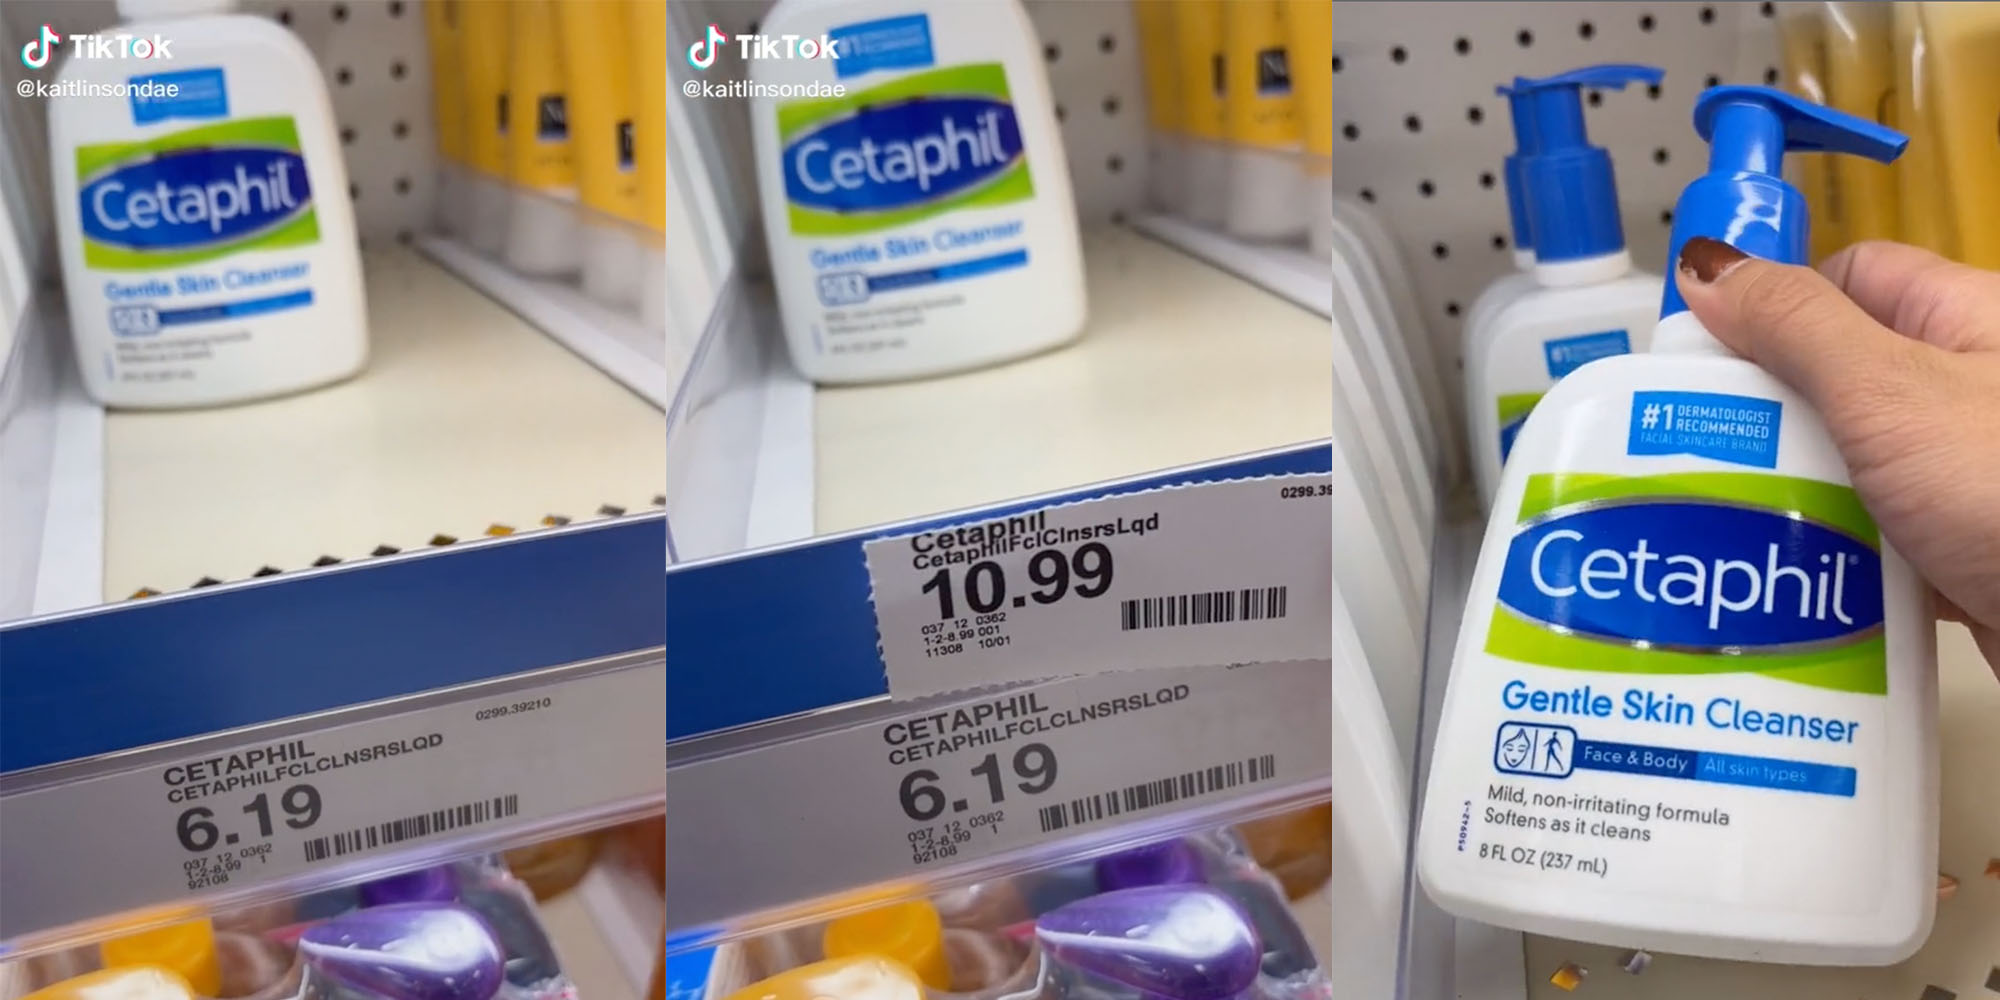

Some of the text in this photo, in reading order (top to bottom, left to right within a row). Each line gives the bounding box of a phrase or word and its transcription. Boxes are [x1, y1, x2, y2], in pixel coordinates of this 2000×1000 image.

[795, 110, 1007, 193] Cetaphil
[93, 160, 297, 234] Cetaphil
[1641, 403, 1674, 430] #1
[1676, 418, 1769, 439] RECOMMENDED
[1677, 404, 1772, 424] DERMATOLOGIST
[1640, 432, 1767, 453] FACIAL SKINCARE BRAND
[911, 511, 1045, 553] Cetaphil
[922, 541, 1113, 620] 10.99
[1531, 529, 1854, 630] Cetaphil
[921, 612, 1007, 635] 037 12 0362
[924, 625, 1000, 646] 1-2-8.99 001
[925, 635, 1011, 658] 11308 10/01
[475, 697, 552, 721] 0299.39210
[883, 692, 1048, 746] CETAPHIL
[889, 684, 1190, 765] CETAPHILFCLCLNSRSLQD
[1501, 680, 1859, 744] Gentle Skin Cleanser
[163, 740, 315, 785] CETAPHIL
[167, 733, 443, 803] CETAPHILFCLCLNSRSLQD
[1584, 746, 1808, 784] Face & Body All skin types
[899, 742, 1057, 822] 6.19
[177, 784, 322, 852] 6.19
[1488, 784, 1731, 826] Mild, non-irritating formula
[907, 810, 1004, 842] 037 12 0362
[1484, 807, 1651, 842] Softens as it cleans
[184, 843, 273, 871] 037 12 0362
[913, 845, 958, 864] 92108
[1479, 843, 1608, 878] 8 FL OZ (237 mL)
[188, 873, 229, 890] 92108
